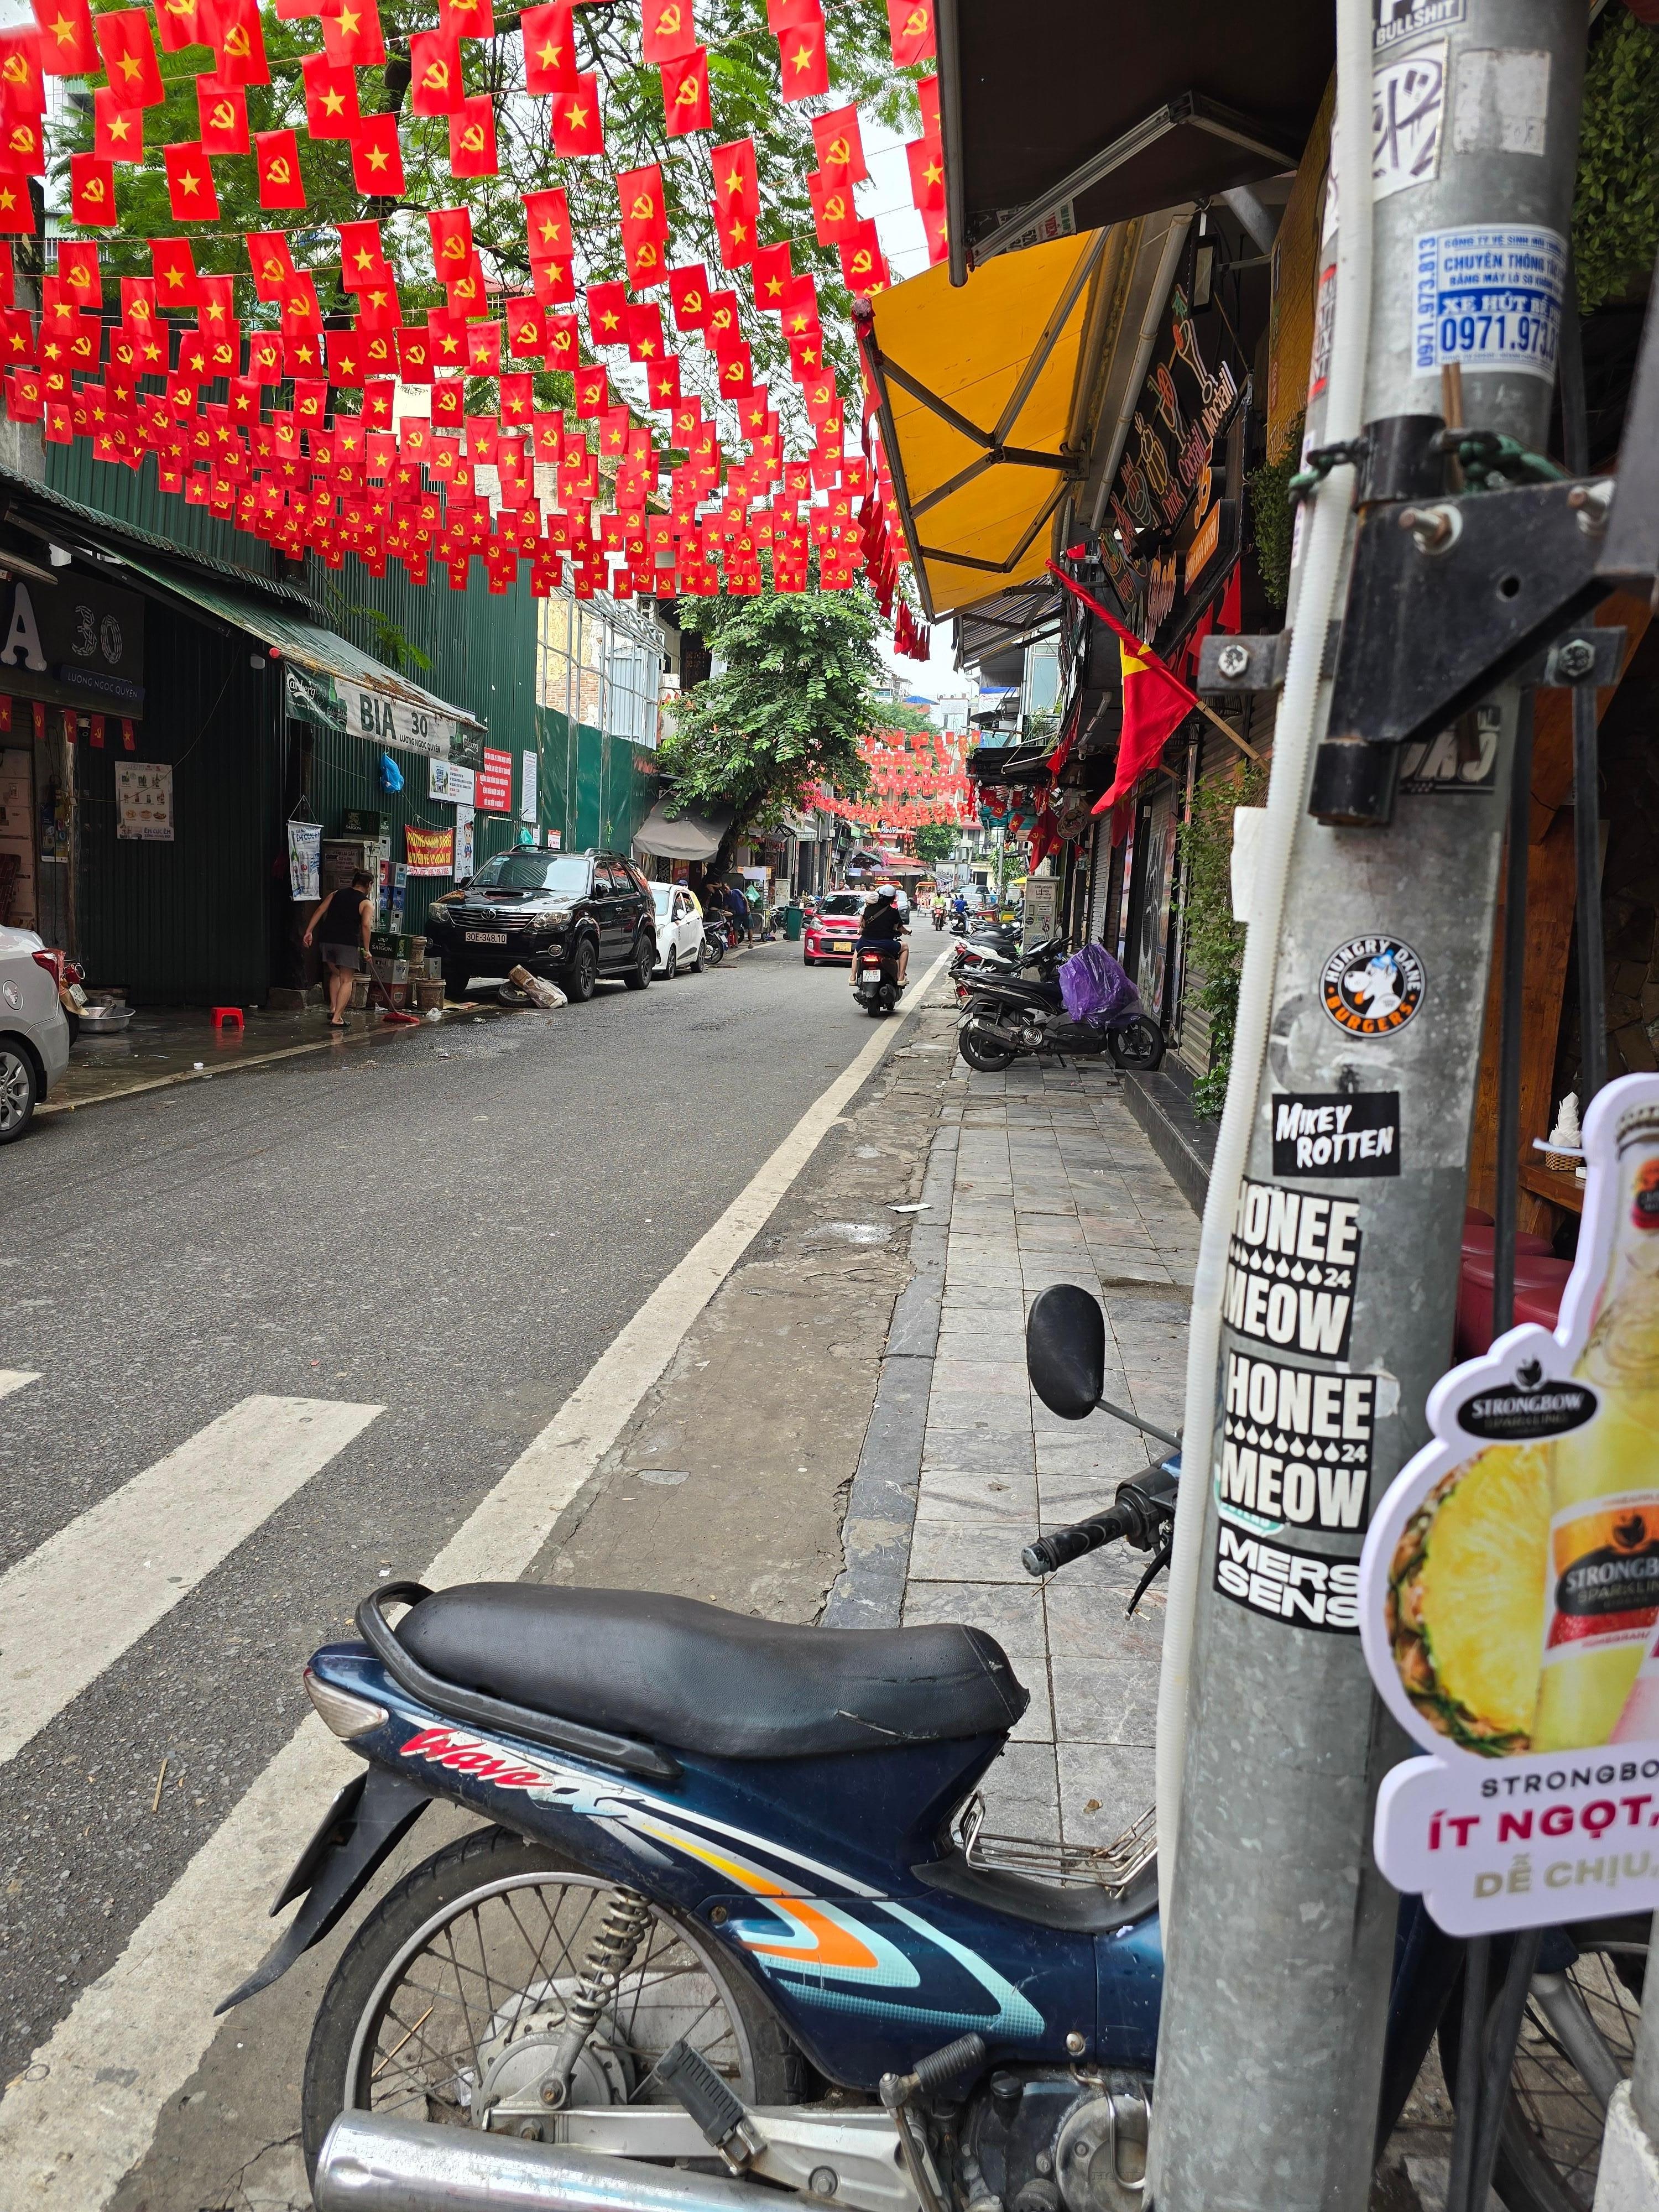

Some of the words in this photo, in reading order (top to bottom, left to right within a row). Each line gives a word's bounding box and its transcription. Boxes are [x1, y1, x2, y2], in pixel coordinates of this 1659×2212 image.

[1376, 1, 1454, 45] BULLSHIT
[1444, 251, 1503, 272] CHUYÊN
[1508, 252, 1545, 273] THÔNG
[1417, 237, 1436, 368] 0971.973.813
[1442, 295, 1477, 315] XE
[71, 604, 123, 664] 30
[359, 693, 397, 741] BIA
[411, 712, 428, 738] 30
[399, 734, 415, 746] LƯƠNG
[466, 932, 507, 944] 30E-348.10
[1325, 940, 1391, 983] HUNGRY
[1394, 948, 1422, 992] DANE
[1327, 995, 1413, 1033] BURGERS
[1275, 1102, 1353, 1142] MIKEY
[1296, 1125, 1395, 1169] ROTTEN
[1324, 1267, 1352, 1288] 24
[1223, 1262, 1351, 1355] MEOW
[1226, 1352, 1373, 1440] HONEE
[1471, 1391, 1585, 1419] STRONGBOW
[1340, 1444, 1368, 1463] 24
[1220, 1439, 1368, 1528] MEOW
[399, 1728, 554, 1789] Wave
[1481, 1759, 1659, 1798] STRONGBO
[1427, 1808, 1481, 1850] ÍT
[1473, 1851, 1532, 1898] DỄ
